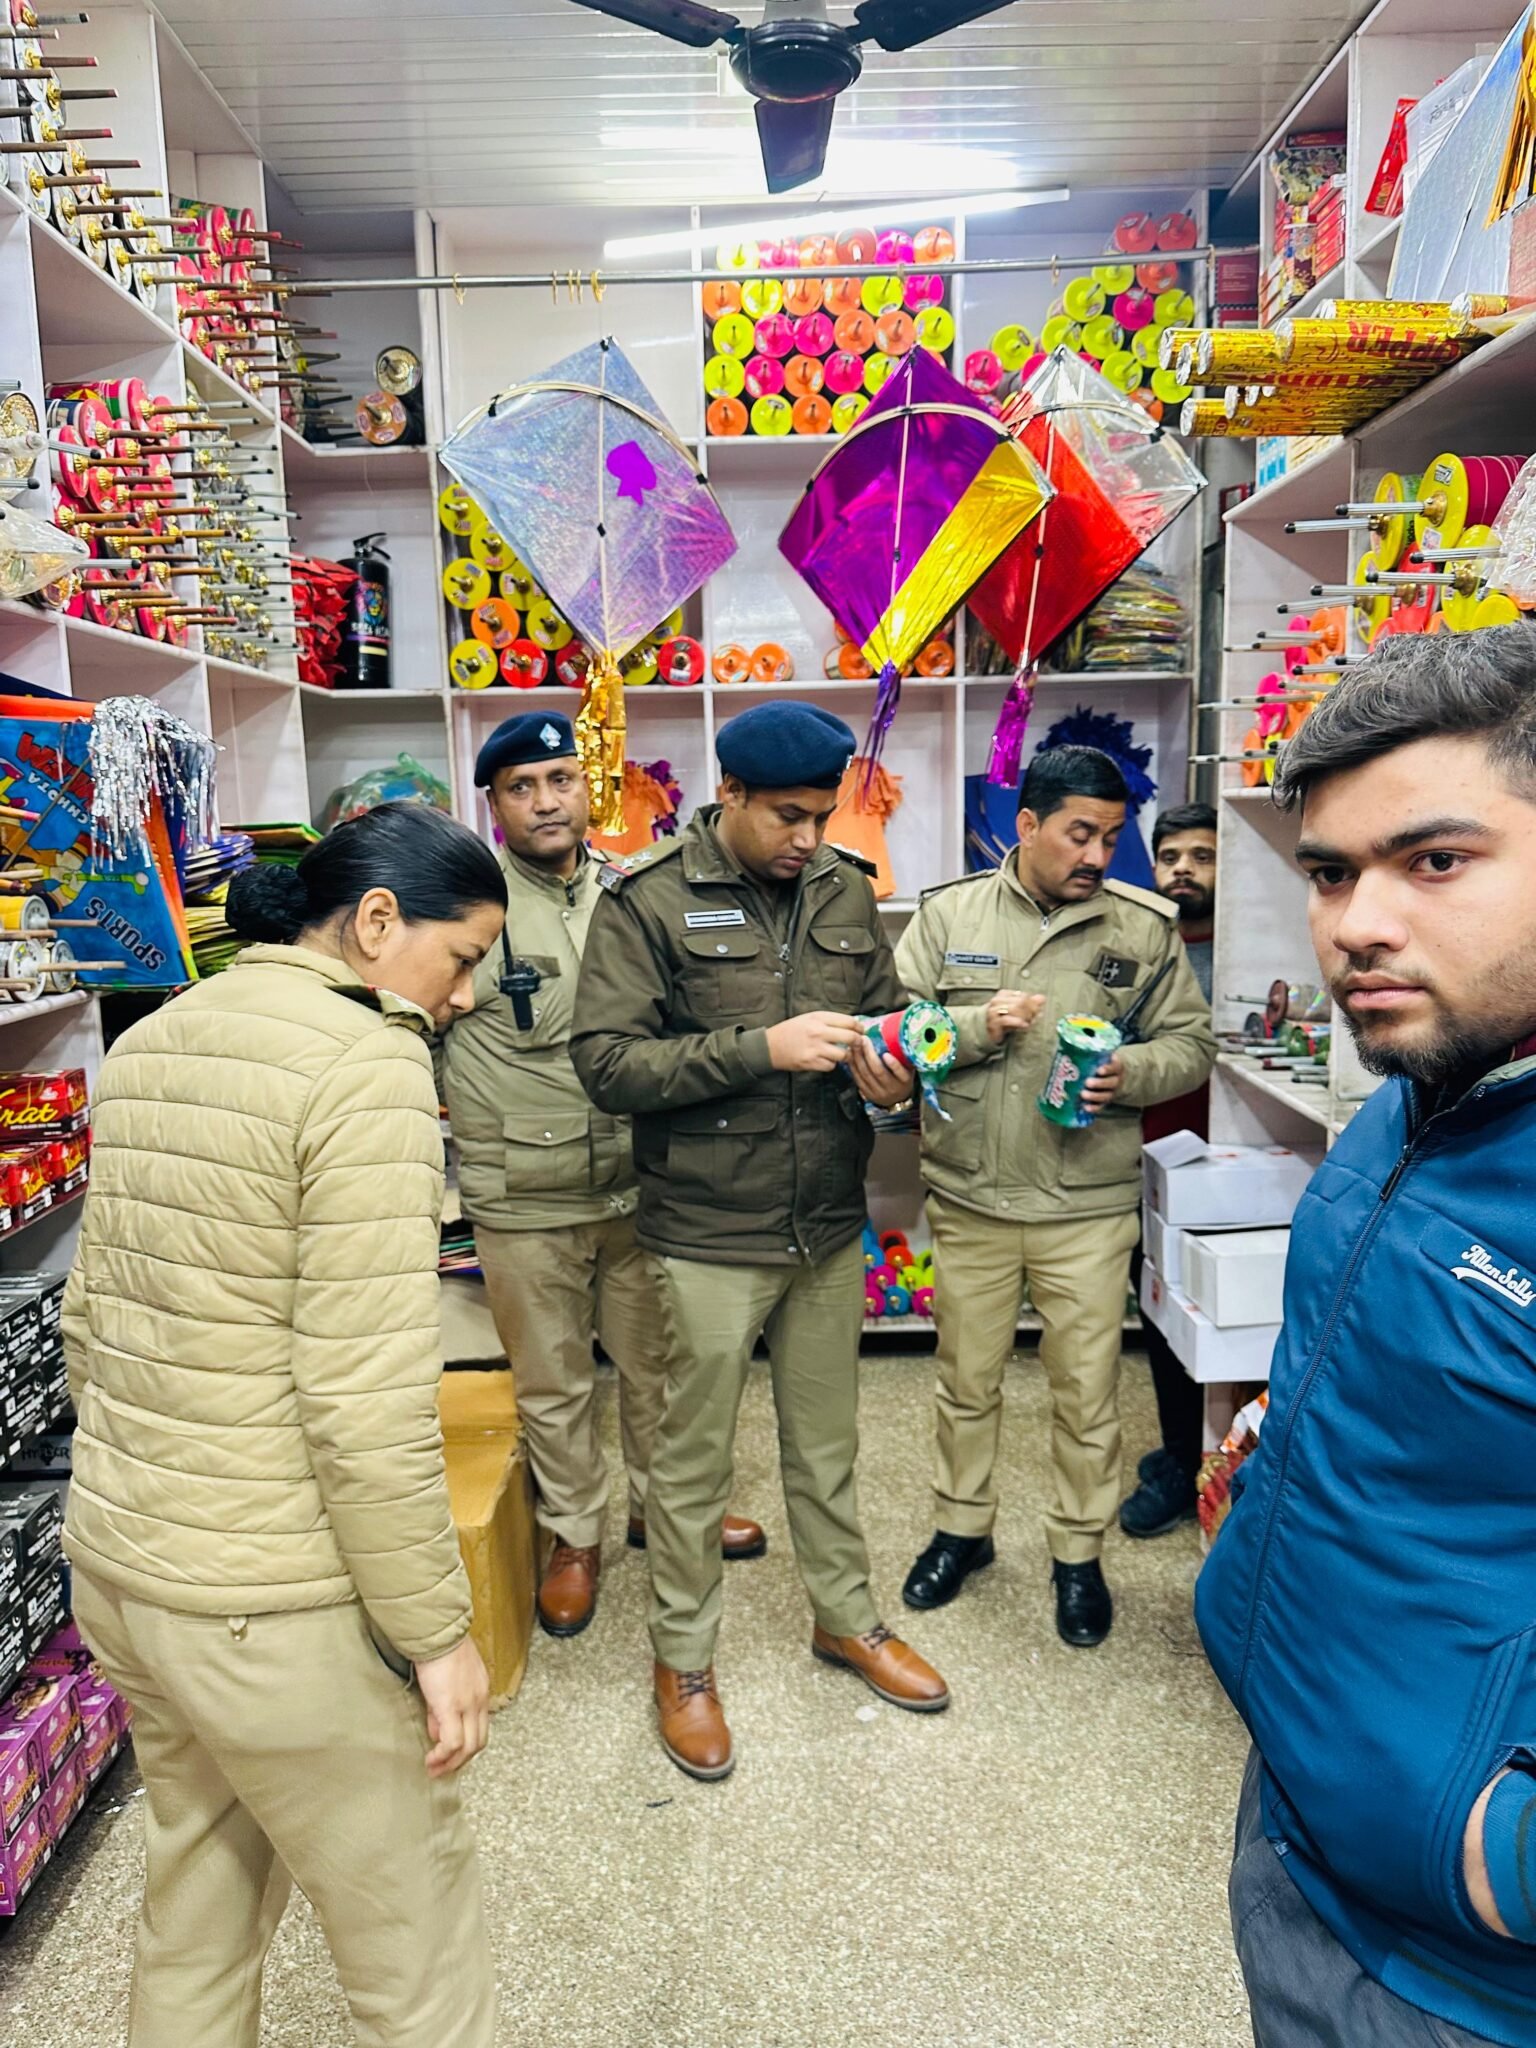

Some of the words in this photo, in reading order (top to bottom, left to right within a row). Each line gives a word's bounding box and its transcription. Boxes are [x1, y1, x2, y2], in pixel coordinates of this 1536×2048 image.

[28, 771, 89, 825] CHHOTA
[83, 896, 167, 973] SPORTS
[1461, 1244, 1501, 1280] Allen
[1497, 1268, 1536, 1304] Solly
